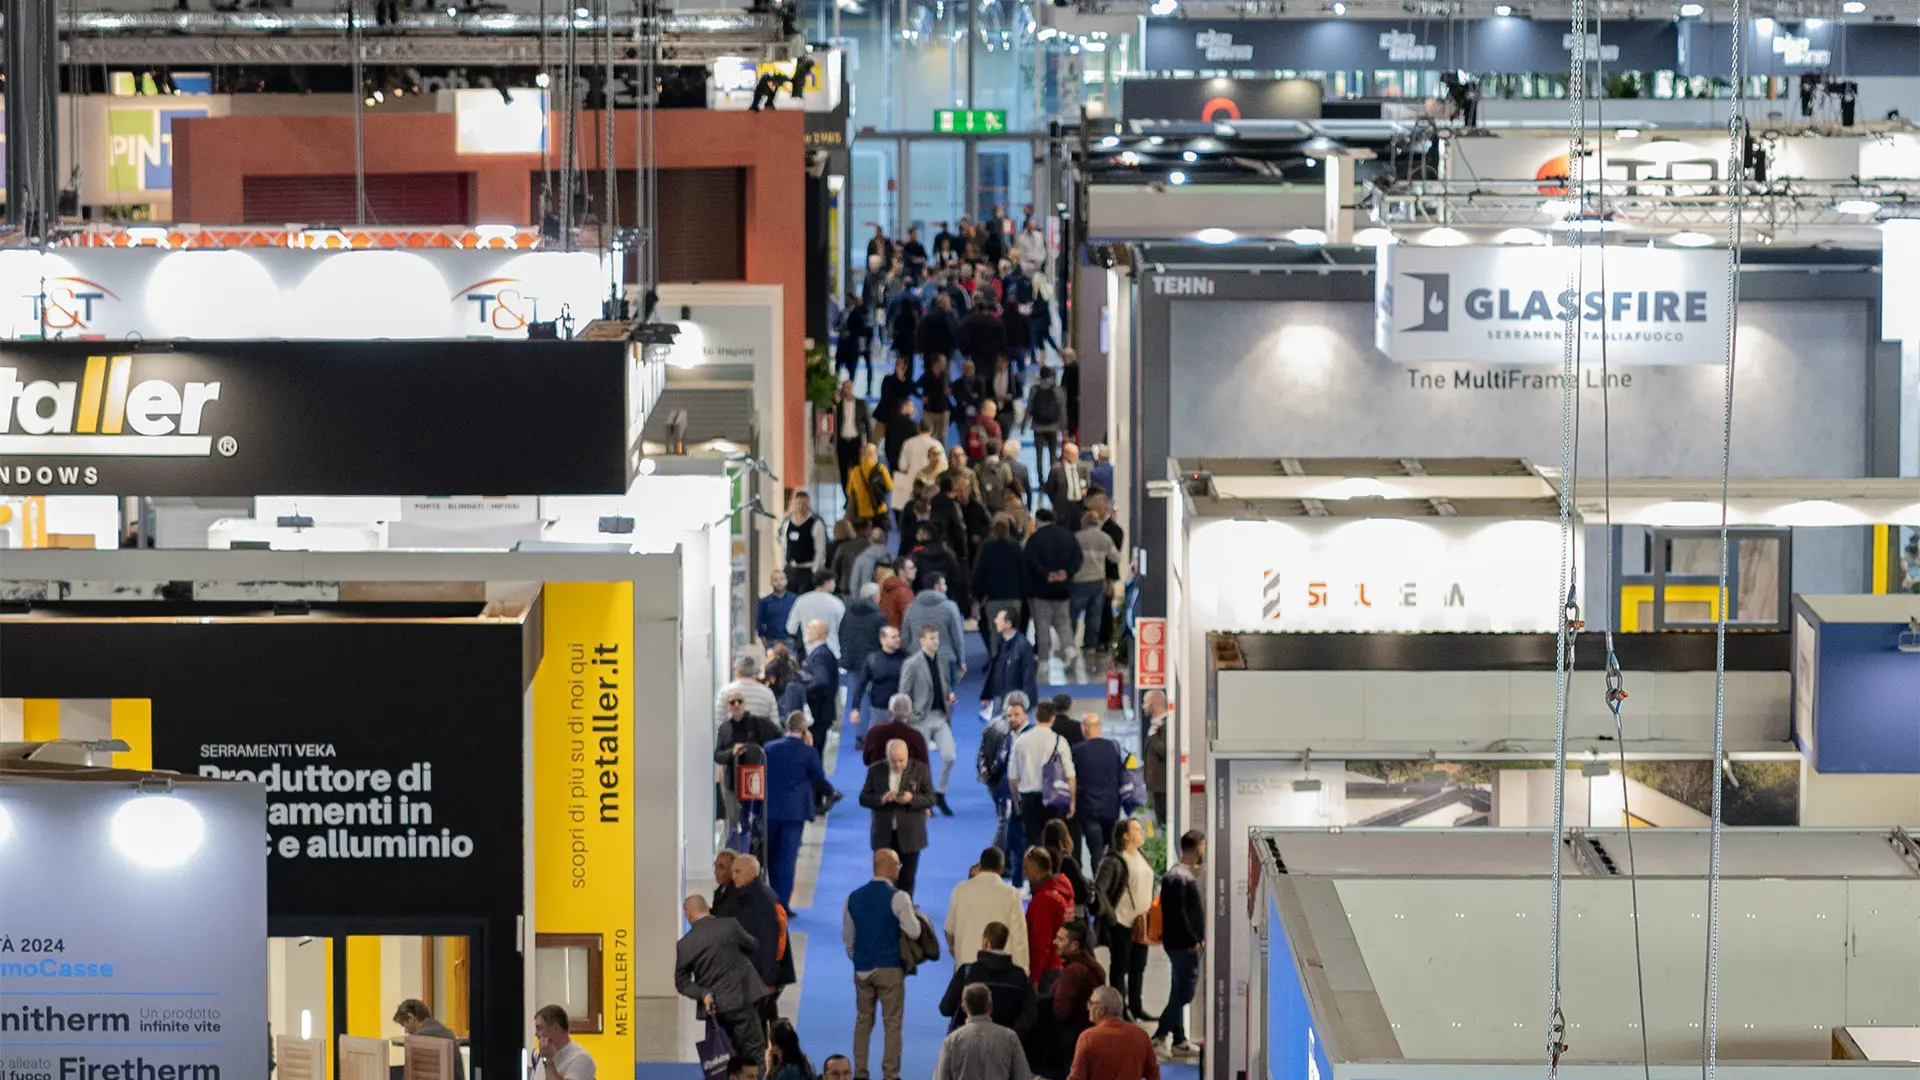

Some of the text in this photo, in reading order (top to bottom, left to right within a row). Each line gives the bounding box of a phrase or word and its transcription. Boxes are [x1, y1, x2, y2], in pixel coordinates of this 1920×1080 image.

[1464, 288, 1708, 323] GLASSFIRE
[1487, 330, 1577, 341] SERRAMENI
[1587, 369, 1633, 389] Line
[568, 643, 588, 675] qui
[568, 680, 585, 710] noi
[568, 716, 585, 735] di
[591, 643, 619, 823] metaller.it
[200, 744, 337, 758] SERRAMENTI VEKA
[572, 739, 585, 762] su
[397, 762, 432, 793] di
[400, 795, 433, 825] in
[568, 804, 585, 823] di
[278, 835, 301, 859] e
[307, 828, 474, 859] alluminio
[570, 828, 588, 889] scopri
[21, 938, 65, 953] 2024
[615, 929, 628, 1036] METALLER 70
[1, 1005, 130, 1032] nitherm
[140, 1007, 221, 1021] Un prodotto
[140, 1020, 222, 1033] infinite vite
[59, 1057, 220, 1080] Firetherm
